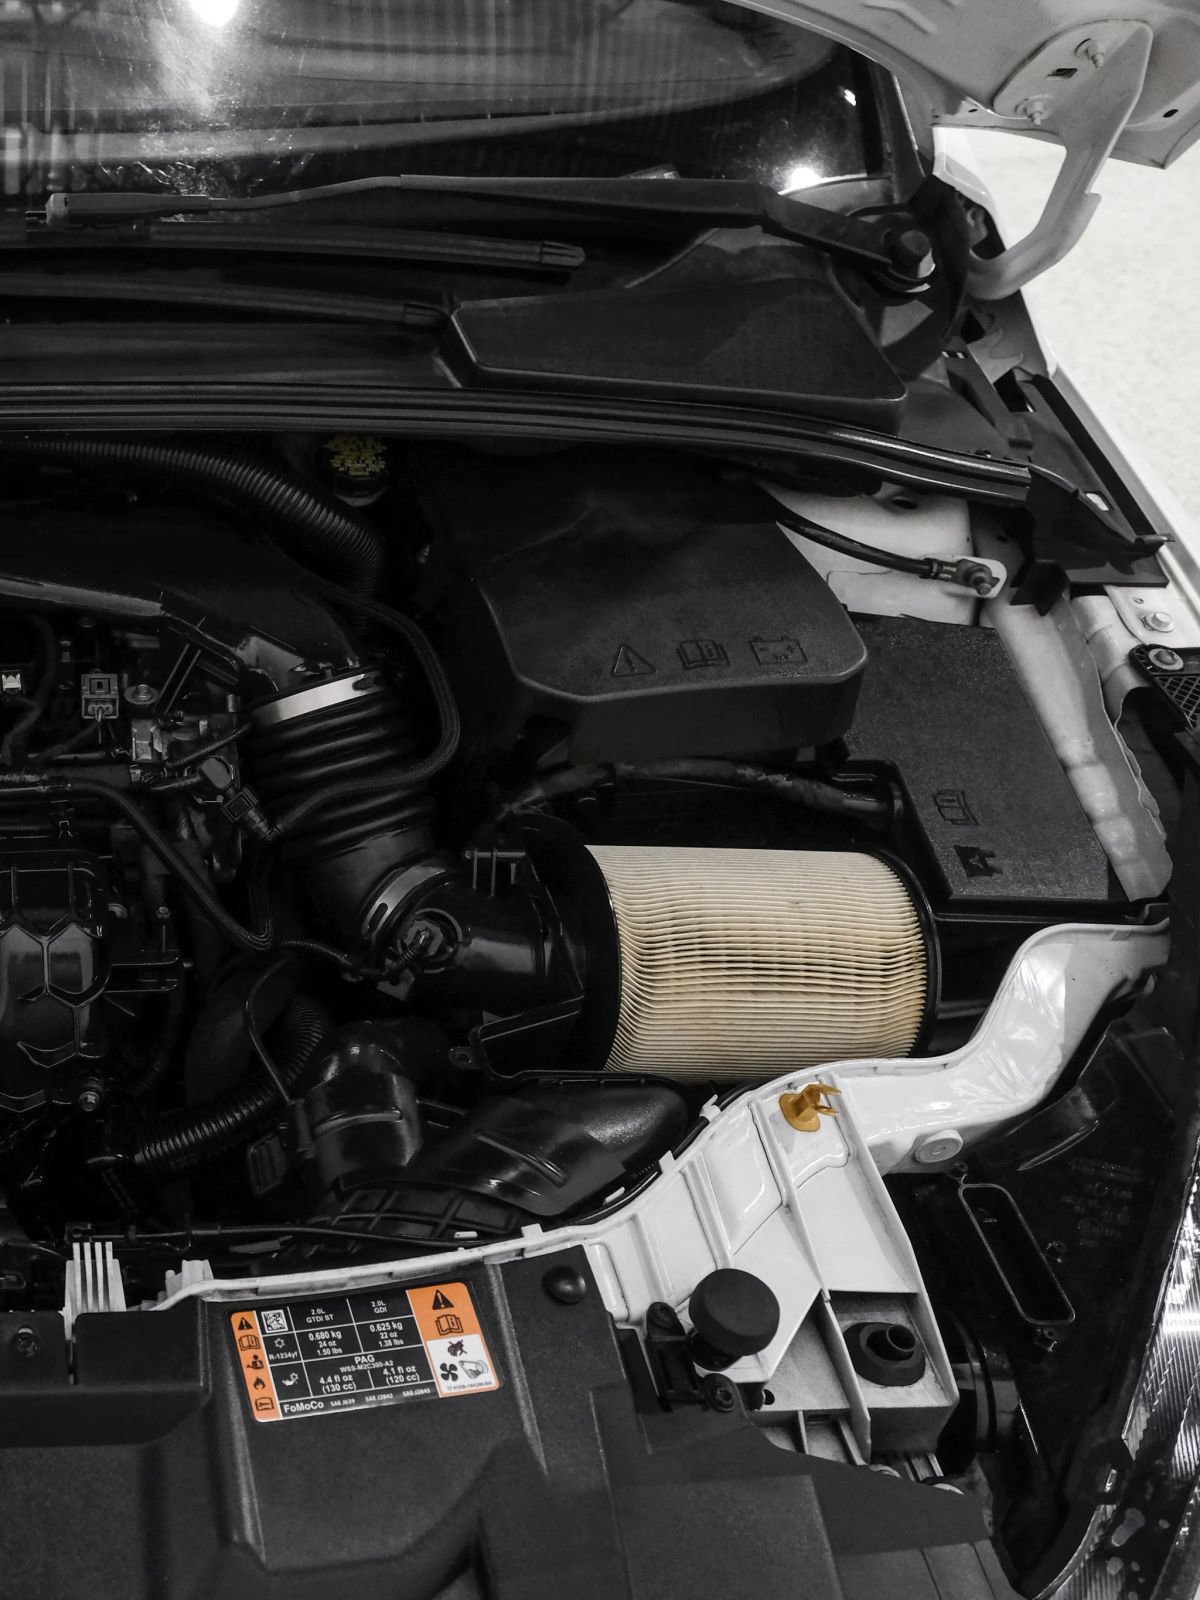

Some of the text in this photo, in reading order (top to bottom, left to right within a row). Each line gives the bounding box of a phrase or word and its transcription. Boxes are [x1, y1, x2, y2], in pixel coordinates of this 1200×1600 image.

[371, 1300, 386, 1308] 2.0L
[306, 1315, 324, 1323] GTDI
[370, 1322, 403, 1333] 0.625 kg
[308, 1330, 342, 1341] 0.680 kg
[269, 1351, 298, 1360] R-1234yf
[354, 1355, 375, 1364] PAG
[383, 1367, 396, 1376] 4.1
[320, 1375, 334, 1384] 4.4
[386, 1373, 420, 1386] (120 cc)
[322, 1382, 357, 1395] (130 cc)
[284, 1402, 324, 1413] FoMoCo
